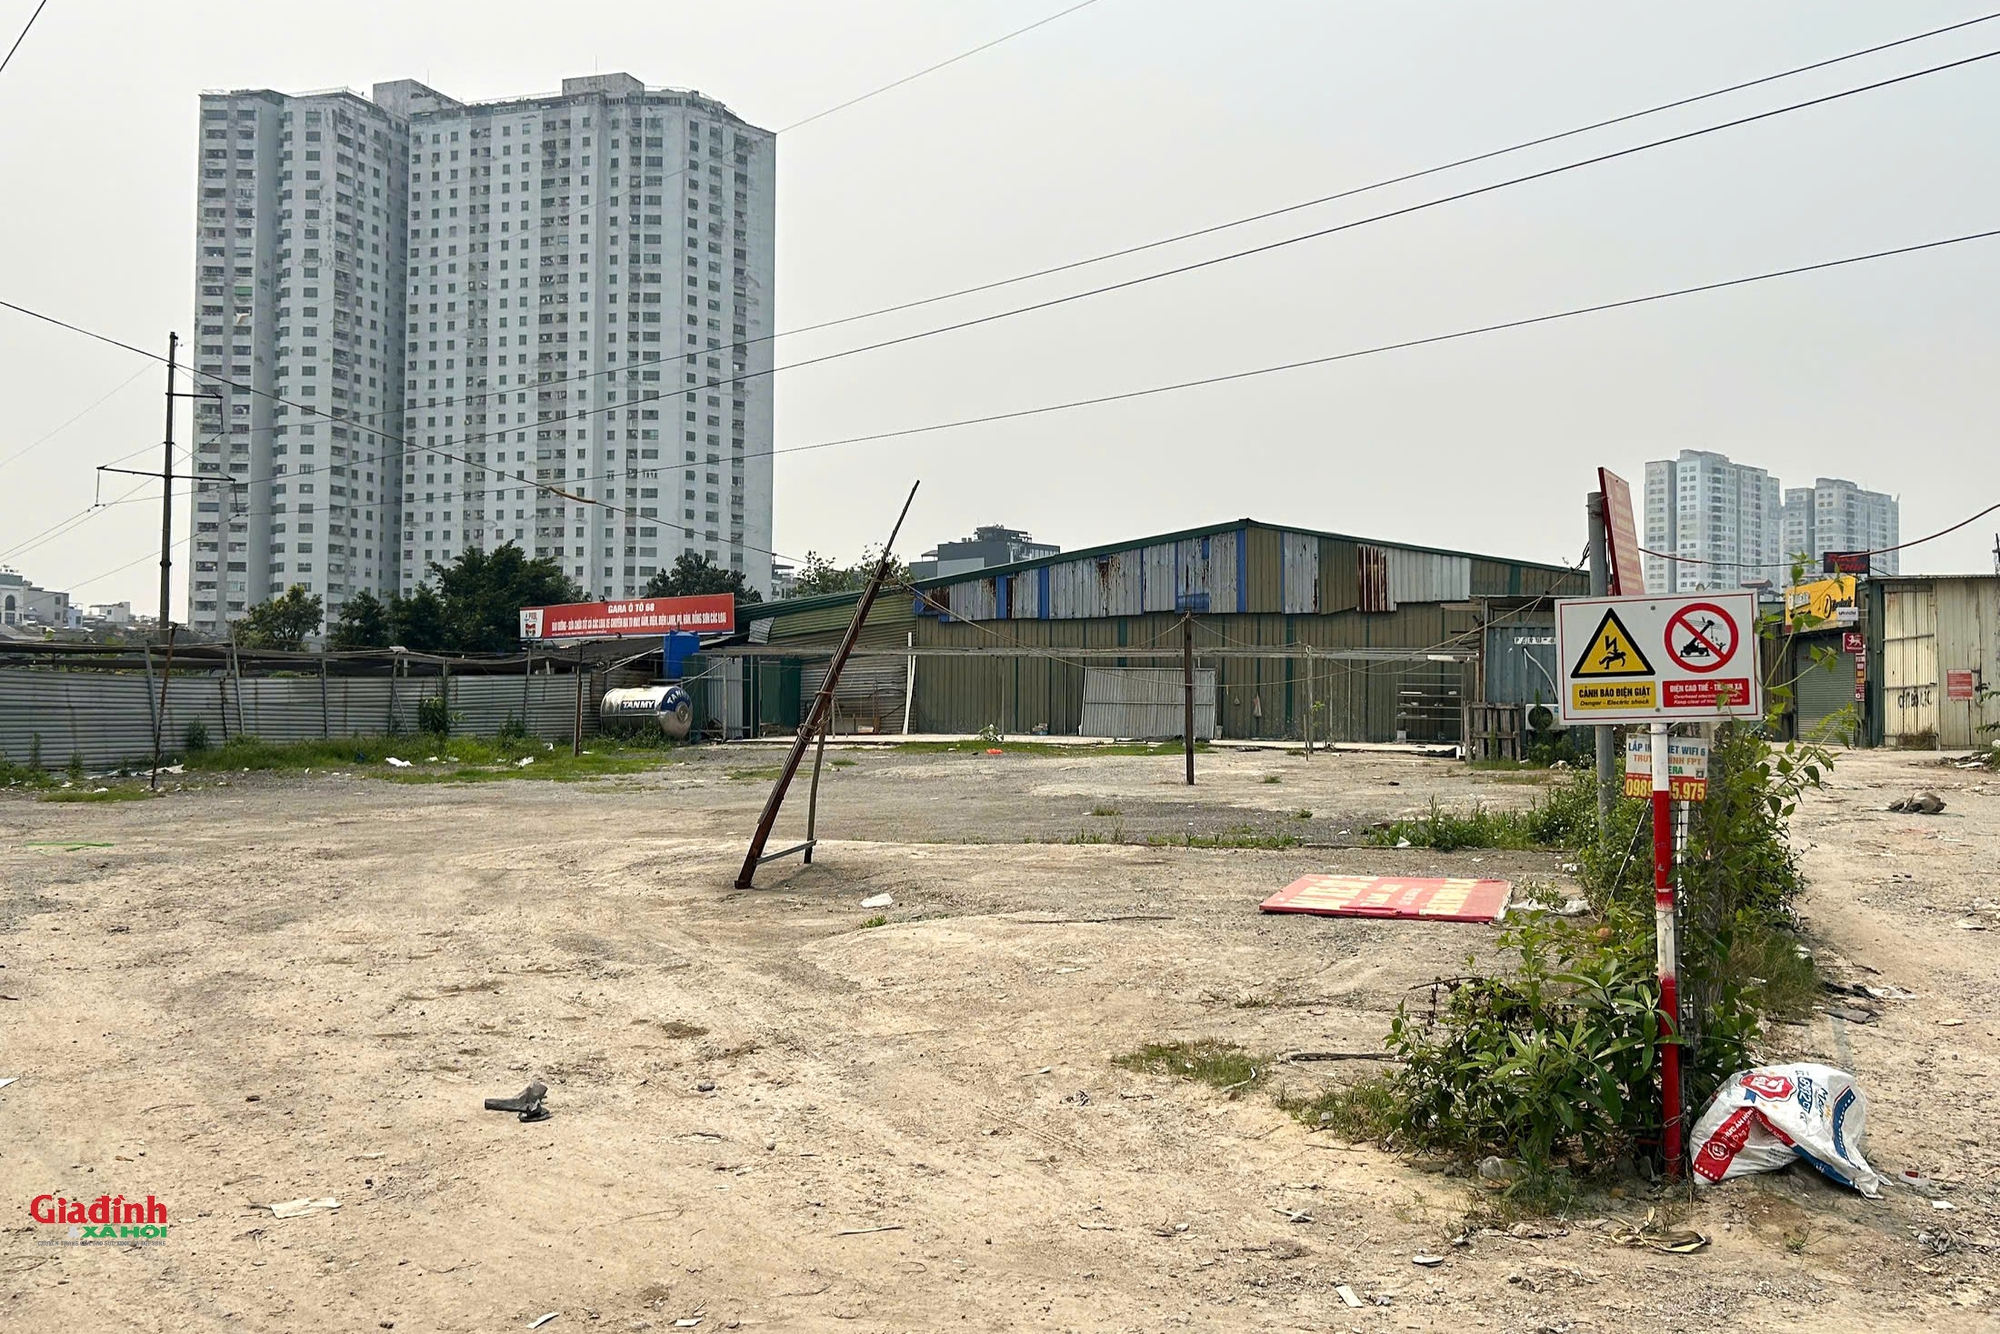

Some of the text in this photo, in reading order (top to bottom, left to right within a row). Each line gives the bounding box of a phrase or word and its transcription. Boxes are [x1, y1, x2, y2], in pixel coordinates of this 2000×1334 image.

[607, 601, 655, 614] GARA Ô TÔ 68
[1578, 686, 1650, 698] CẢNH BÁO ĐIỆN GIẬT
[1670, 684, 1684, 693] ĐIỆN
[1698, 682, 1709, 691] THẾ
[1628, 740, 1643, 752] LẮP
[1682, 746, 1698, 756] WIFI
[1687, 758, 1701, 766] FPT
